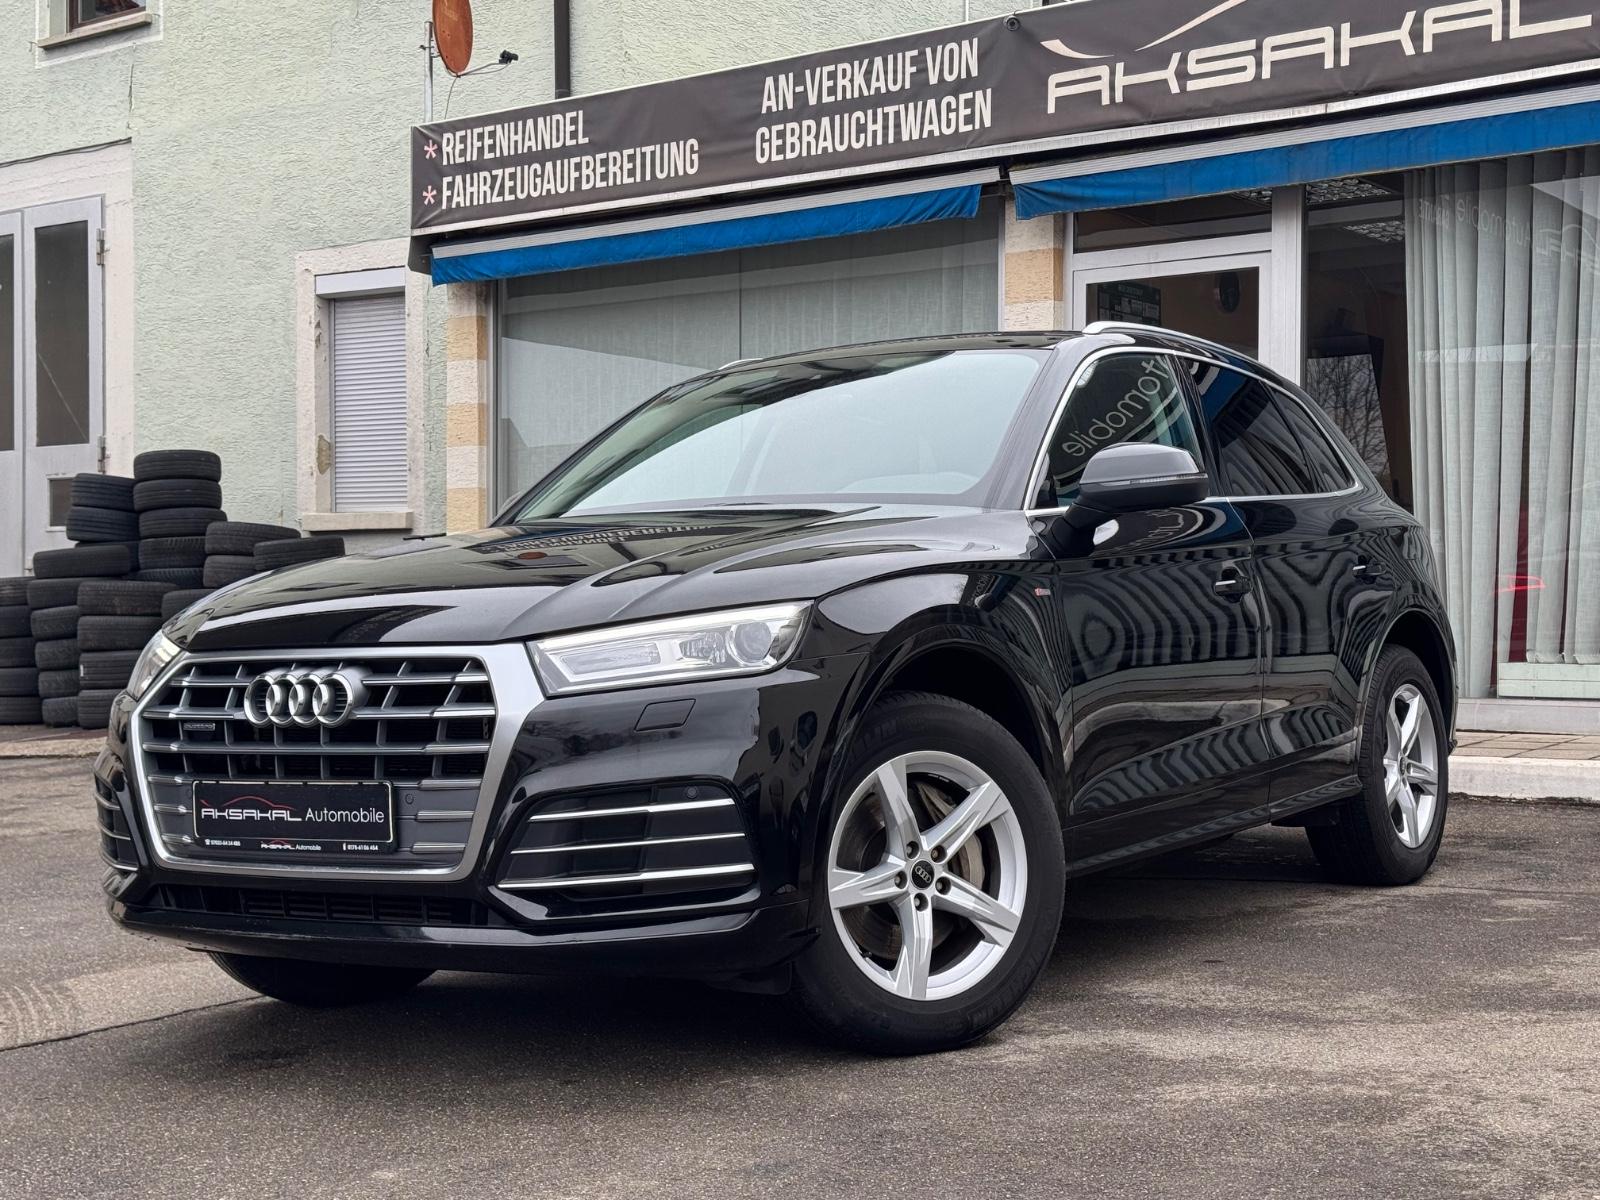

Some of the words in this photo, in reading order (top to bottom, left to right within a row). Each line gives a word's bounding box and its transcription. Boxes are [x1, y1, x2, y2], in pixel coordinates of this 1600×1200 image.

[761, 50, 918, 114] AN-VERKAUF
[925, 37, 978, 86] VON
[1047, 0, 1592, 114] AKSAKAL
[442, 110, 589, 166] REIFENHANDEL
[755, 88, 992, 164] GEBRAUCHTWAGEN
[441, 138, 699, 210] FAHRZEUGAUFBEREITUNG
[201, 808, 302, 822] AKSAKAL
[305, 807, 385, 823] Automobile
